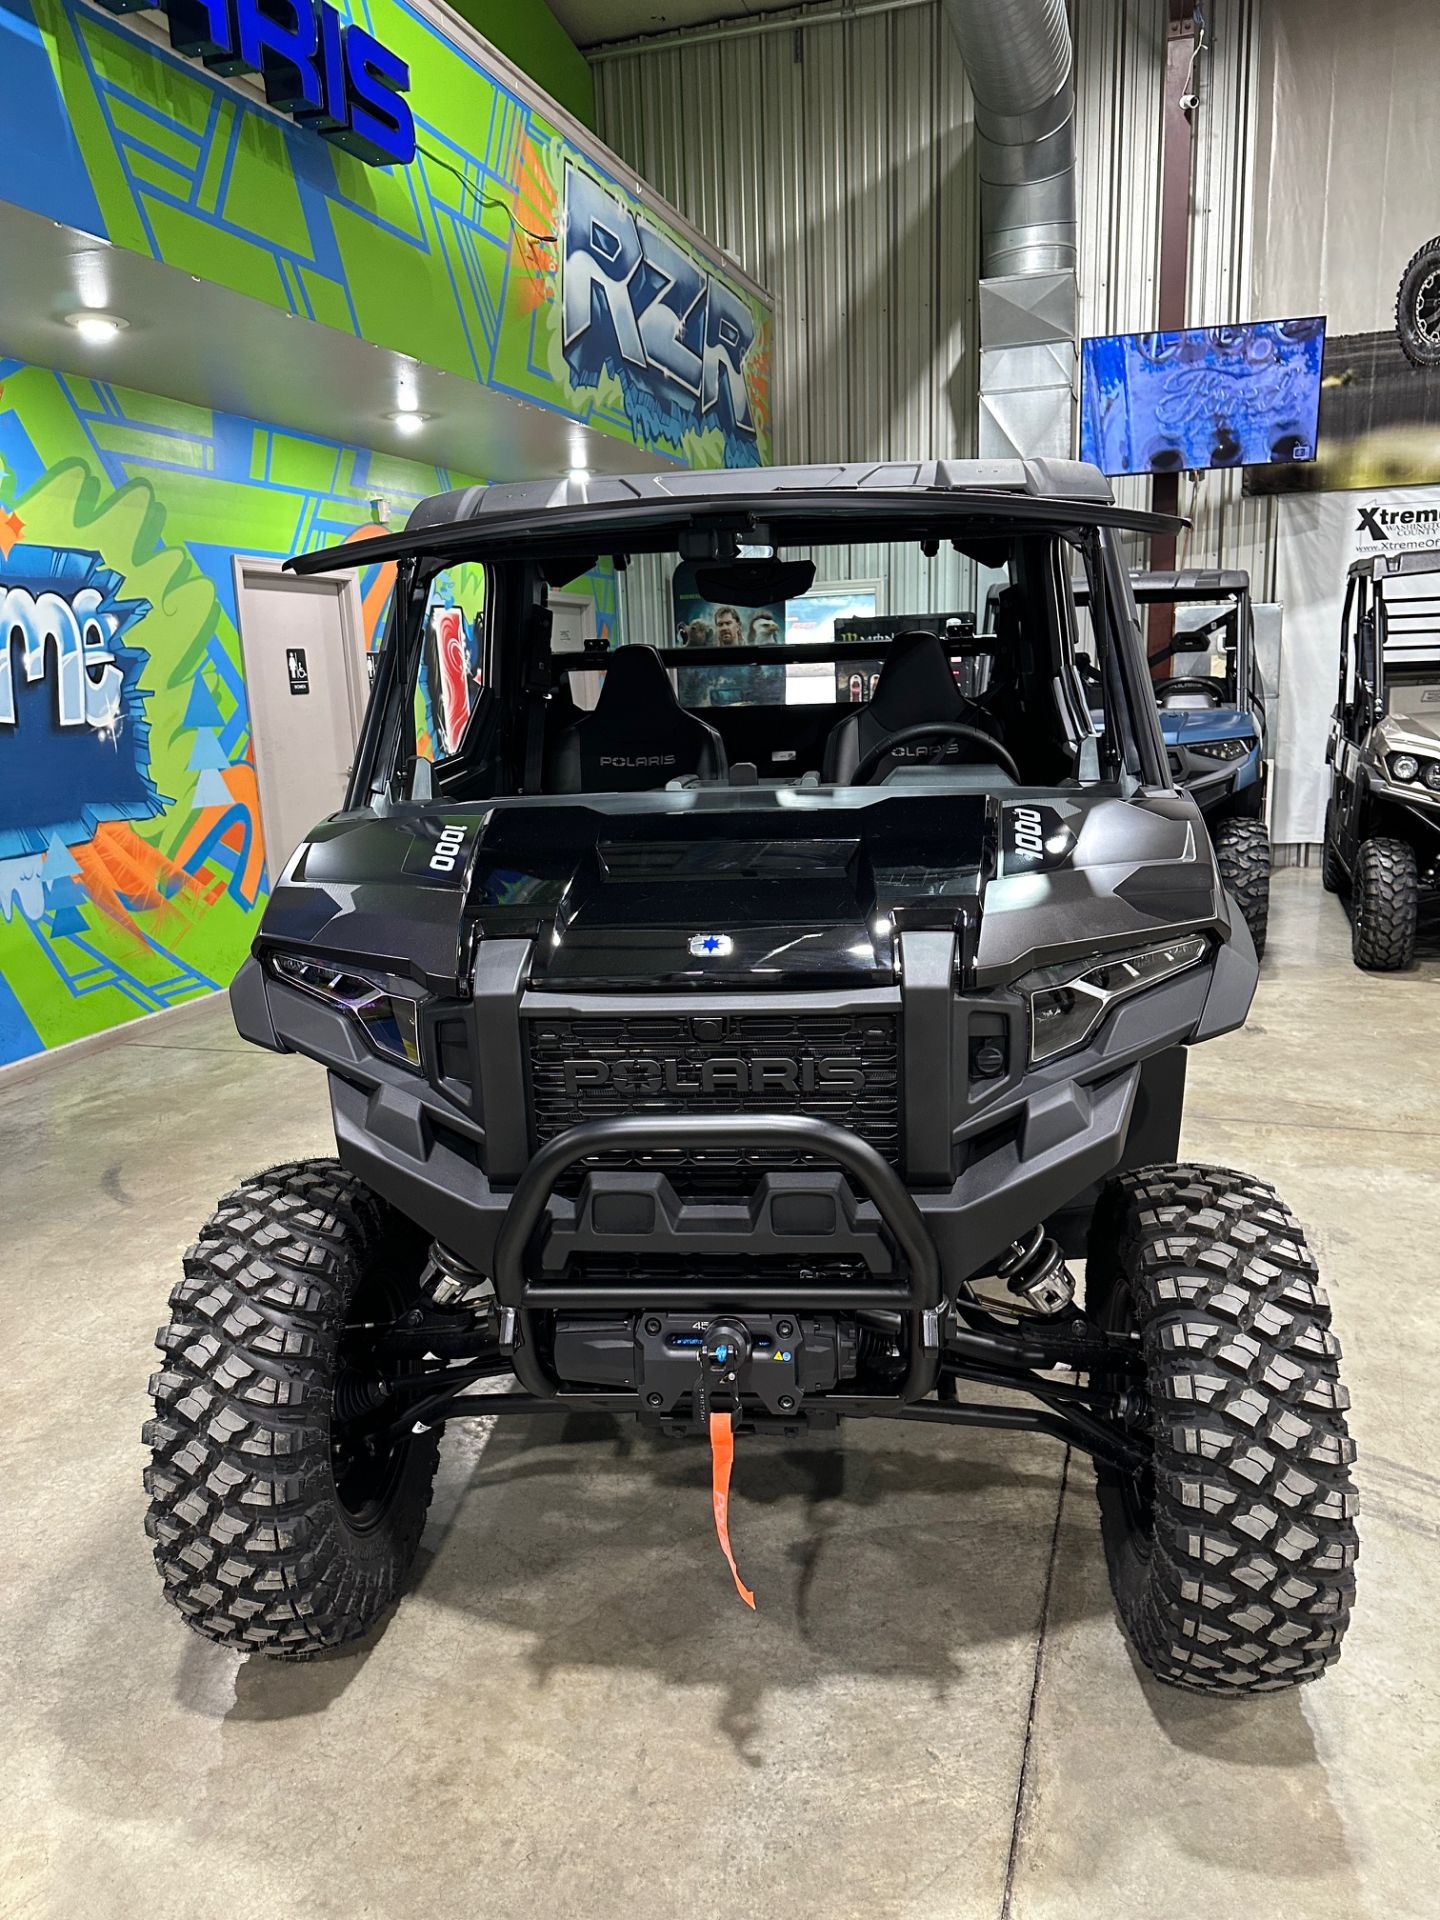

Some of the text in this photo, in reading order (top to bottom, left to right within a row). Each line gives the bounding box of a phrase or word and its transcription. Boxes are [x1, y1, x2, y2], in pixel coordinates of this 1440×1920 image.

[562, 157, 758, 434] RZR
[1355, 507, 1440, 541] Xtrem
[600, 754, 676, 767] POLARIS
[429, 824, 468, 872] 1000
[1014, 808, 1043, 860] 1000
[563, 1057, 866, 1095] POLARIS
